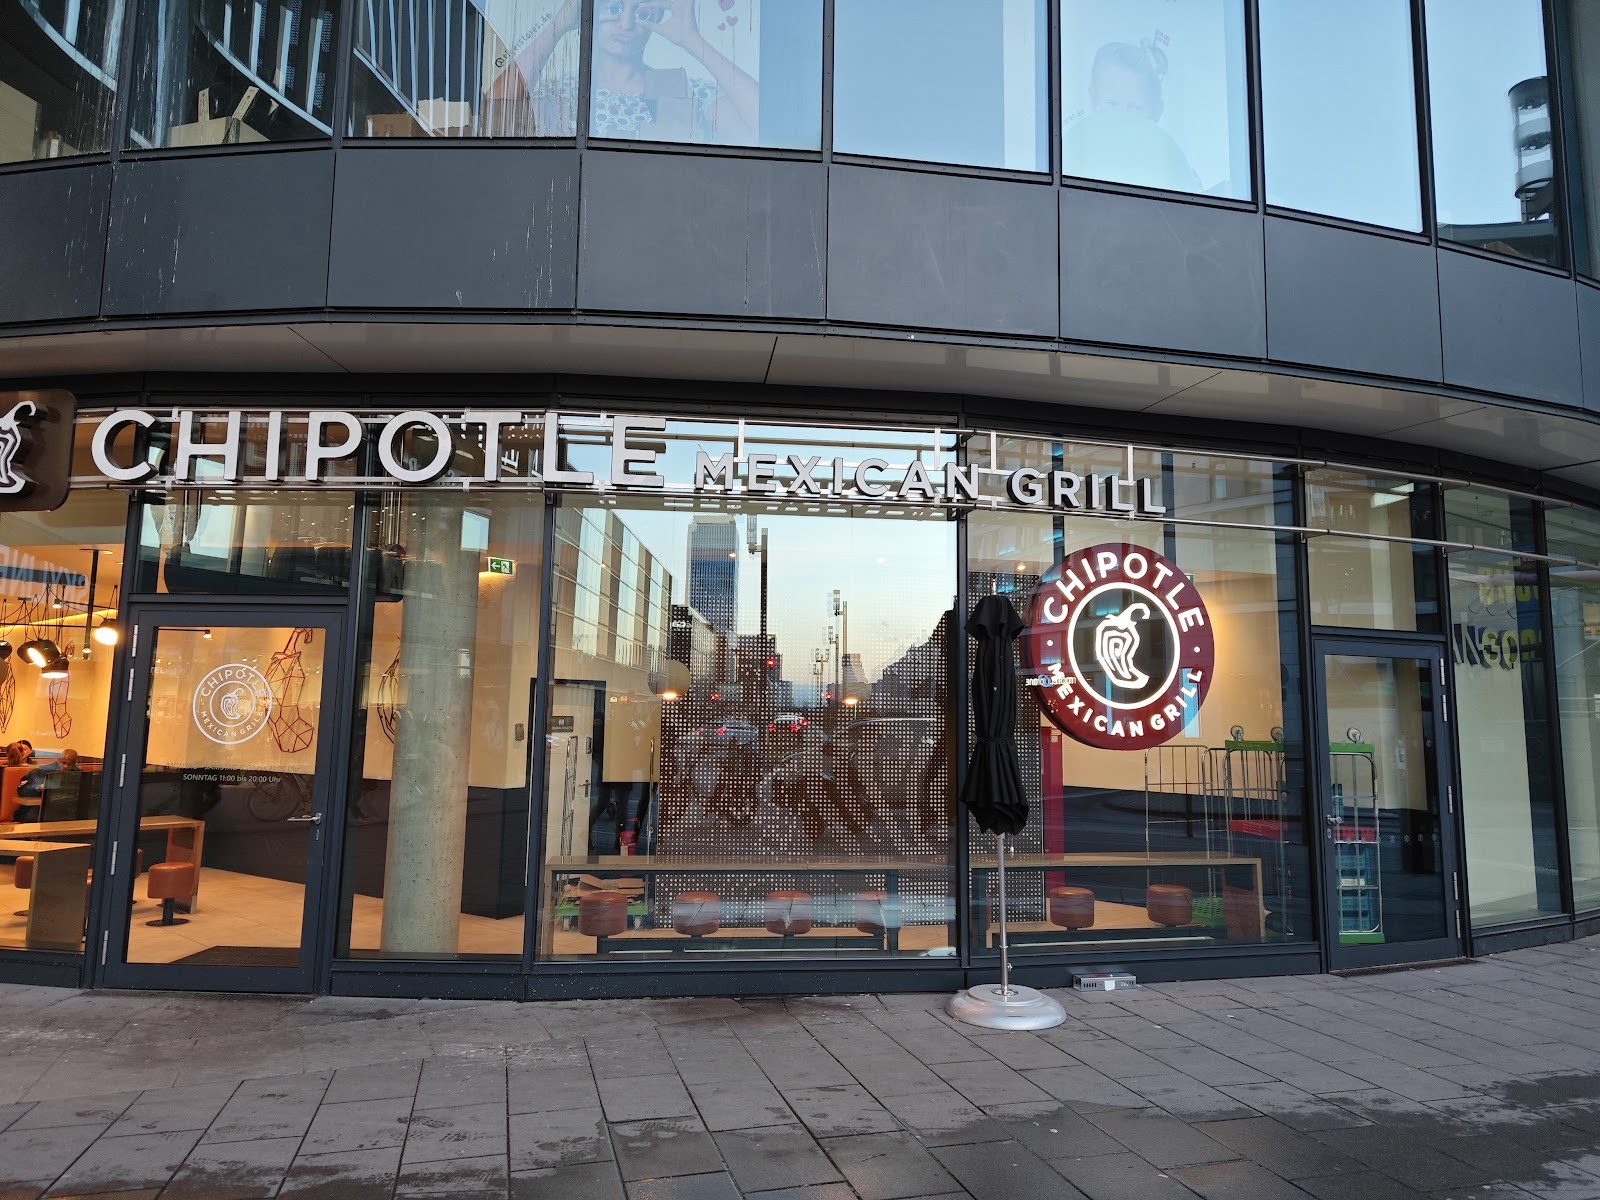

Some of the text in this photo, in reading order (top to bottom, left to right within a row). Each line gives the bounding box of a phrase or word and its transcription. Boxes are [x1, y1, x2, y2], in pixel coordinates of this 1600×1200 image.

[91, 409, 1167, 514] CHIPOTLE MEXICAN GRILL
[1043, 551, 1206, 633] CHIPOTLE
[200, 669, 266, 698] CHIPOTLE
[1047, 662, 1203, 738] MEXICAN GRILL
[200, 710, 264, 738] MEXICAN GRILL
[182, 773, 282, 783] SONNTAG 11:00 bis 20:00 Uhr
